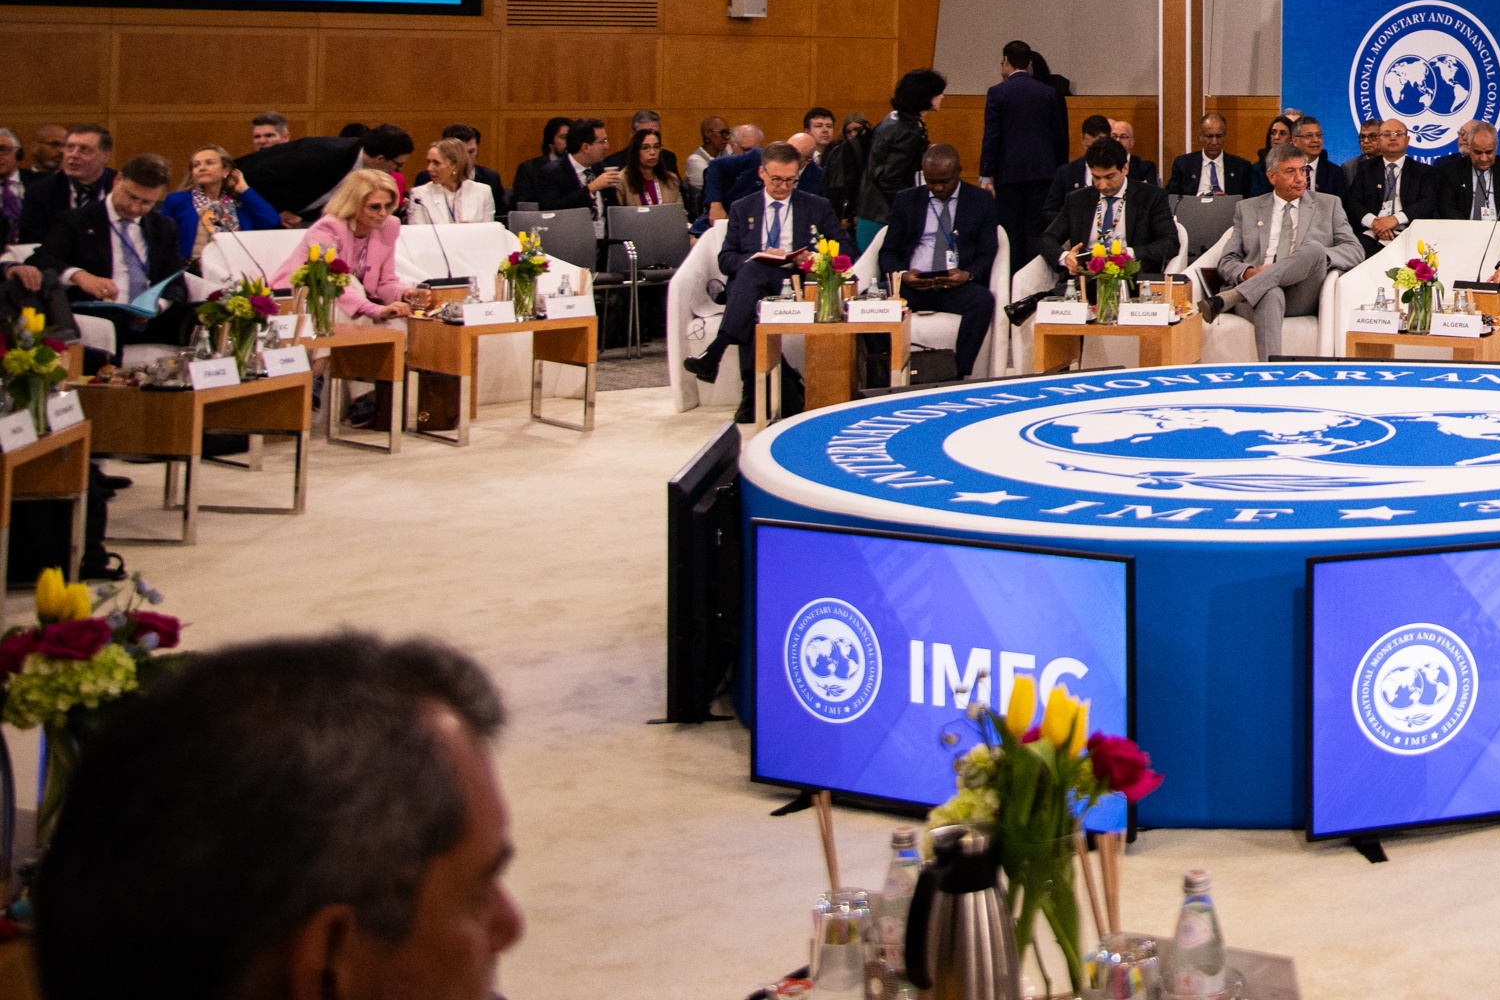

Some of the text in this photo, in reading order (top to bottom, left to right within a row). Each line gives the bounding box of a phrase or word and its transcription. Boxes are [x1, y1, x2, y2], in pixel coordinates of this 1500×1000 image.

[1371, 12, 1426, 55] MONETARY
[1428, 12, 1454, 26] AND
[1454, 20, 1492, 80] FINANCIAL
[774, 308, 802, 316] CANADA
[860, 307, 890, 316] BURUNDI
[1051, 308, 1072, 316] BRAZIL
[1130, 310, 1158, 318] BELGIUM
[1356, 317, 1391, 325] ARGENTINA
[1442, 321, 1469, 329] ALGERIA
[825, 391, 1048, 490] INTERNATIONAL
[1045, 369, 1422, 396] MONETARY
[1038, 501, 1296, 525] IMF
[833, 606, 849, 618] AND
[1361, 631, 1470, 739] INTERNATIONAL MONETARY AND FINANCIAL COMMITTEE
[823, 705, 842, 715] IMF
[1404, 735, 1429, 746] IMF
